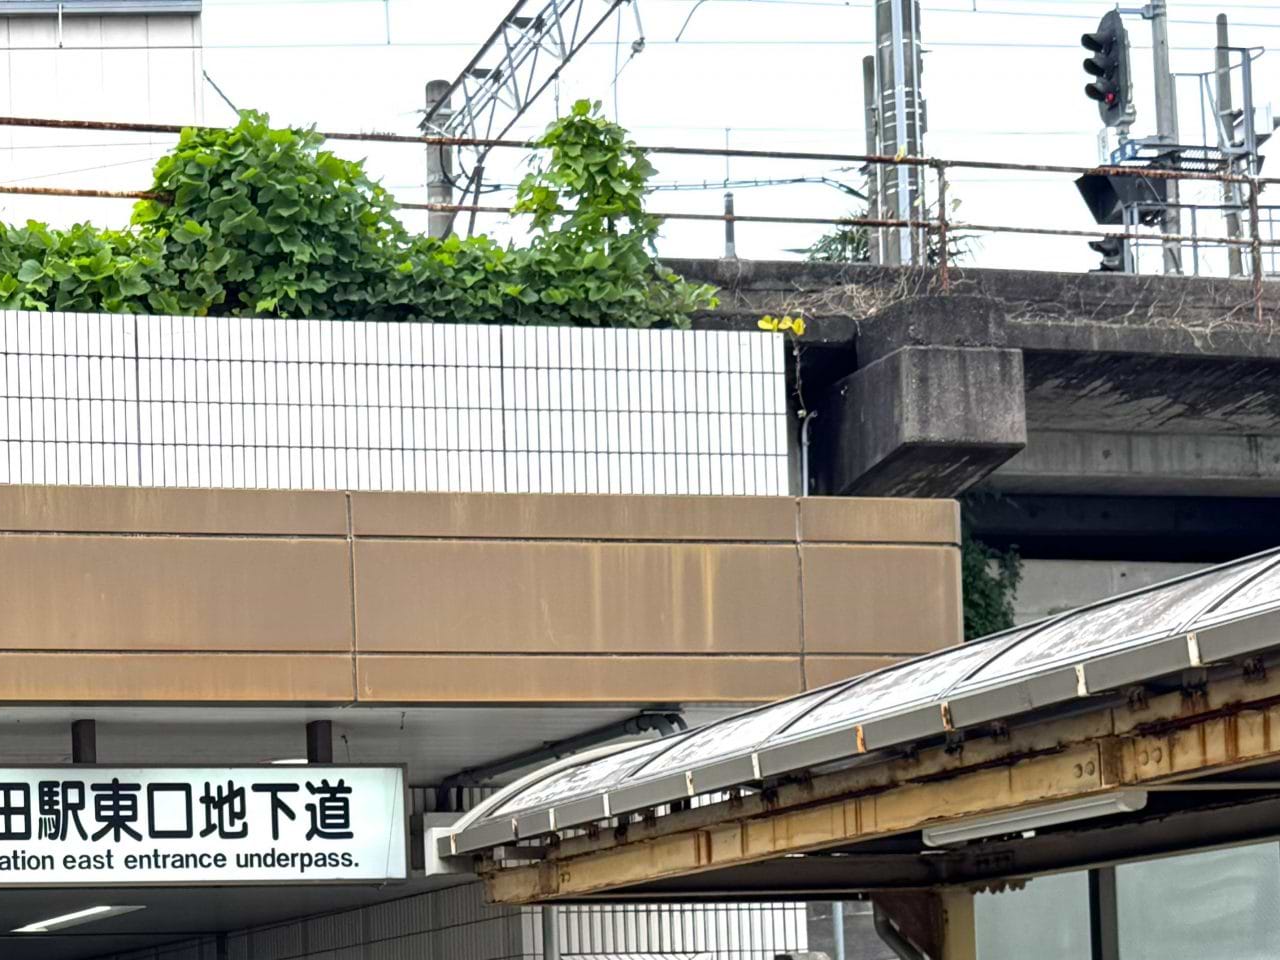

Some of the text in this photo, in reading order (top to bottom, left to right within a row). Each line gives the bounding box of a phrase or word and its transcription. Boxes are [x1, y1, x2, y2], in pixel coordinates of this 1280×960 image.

[62, 849, 114, 870] east
[124, 848, 227, 869] entrance
[235, 847, 359, 873] underpass.
